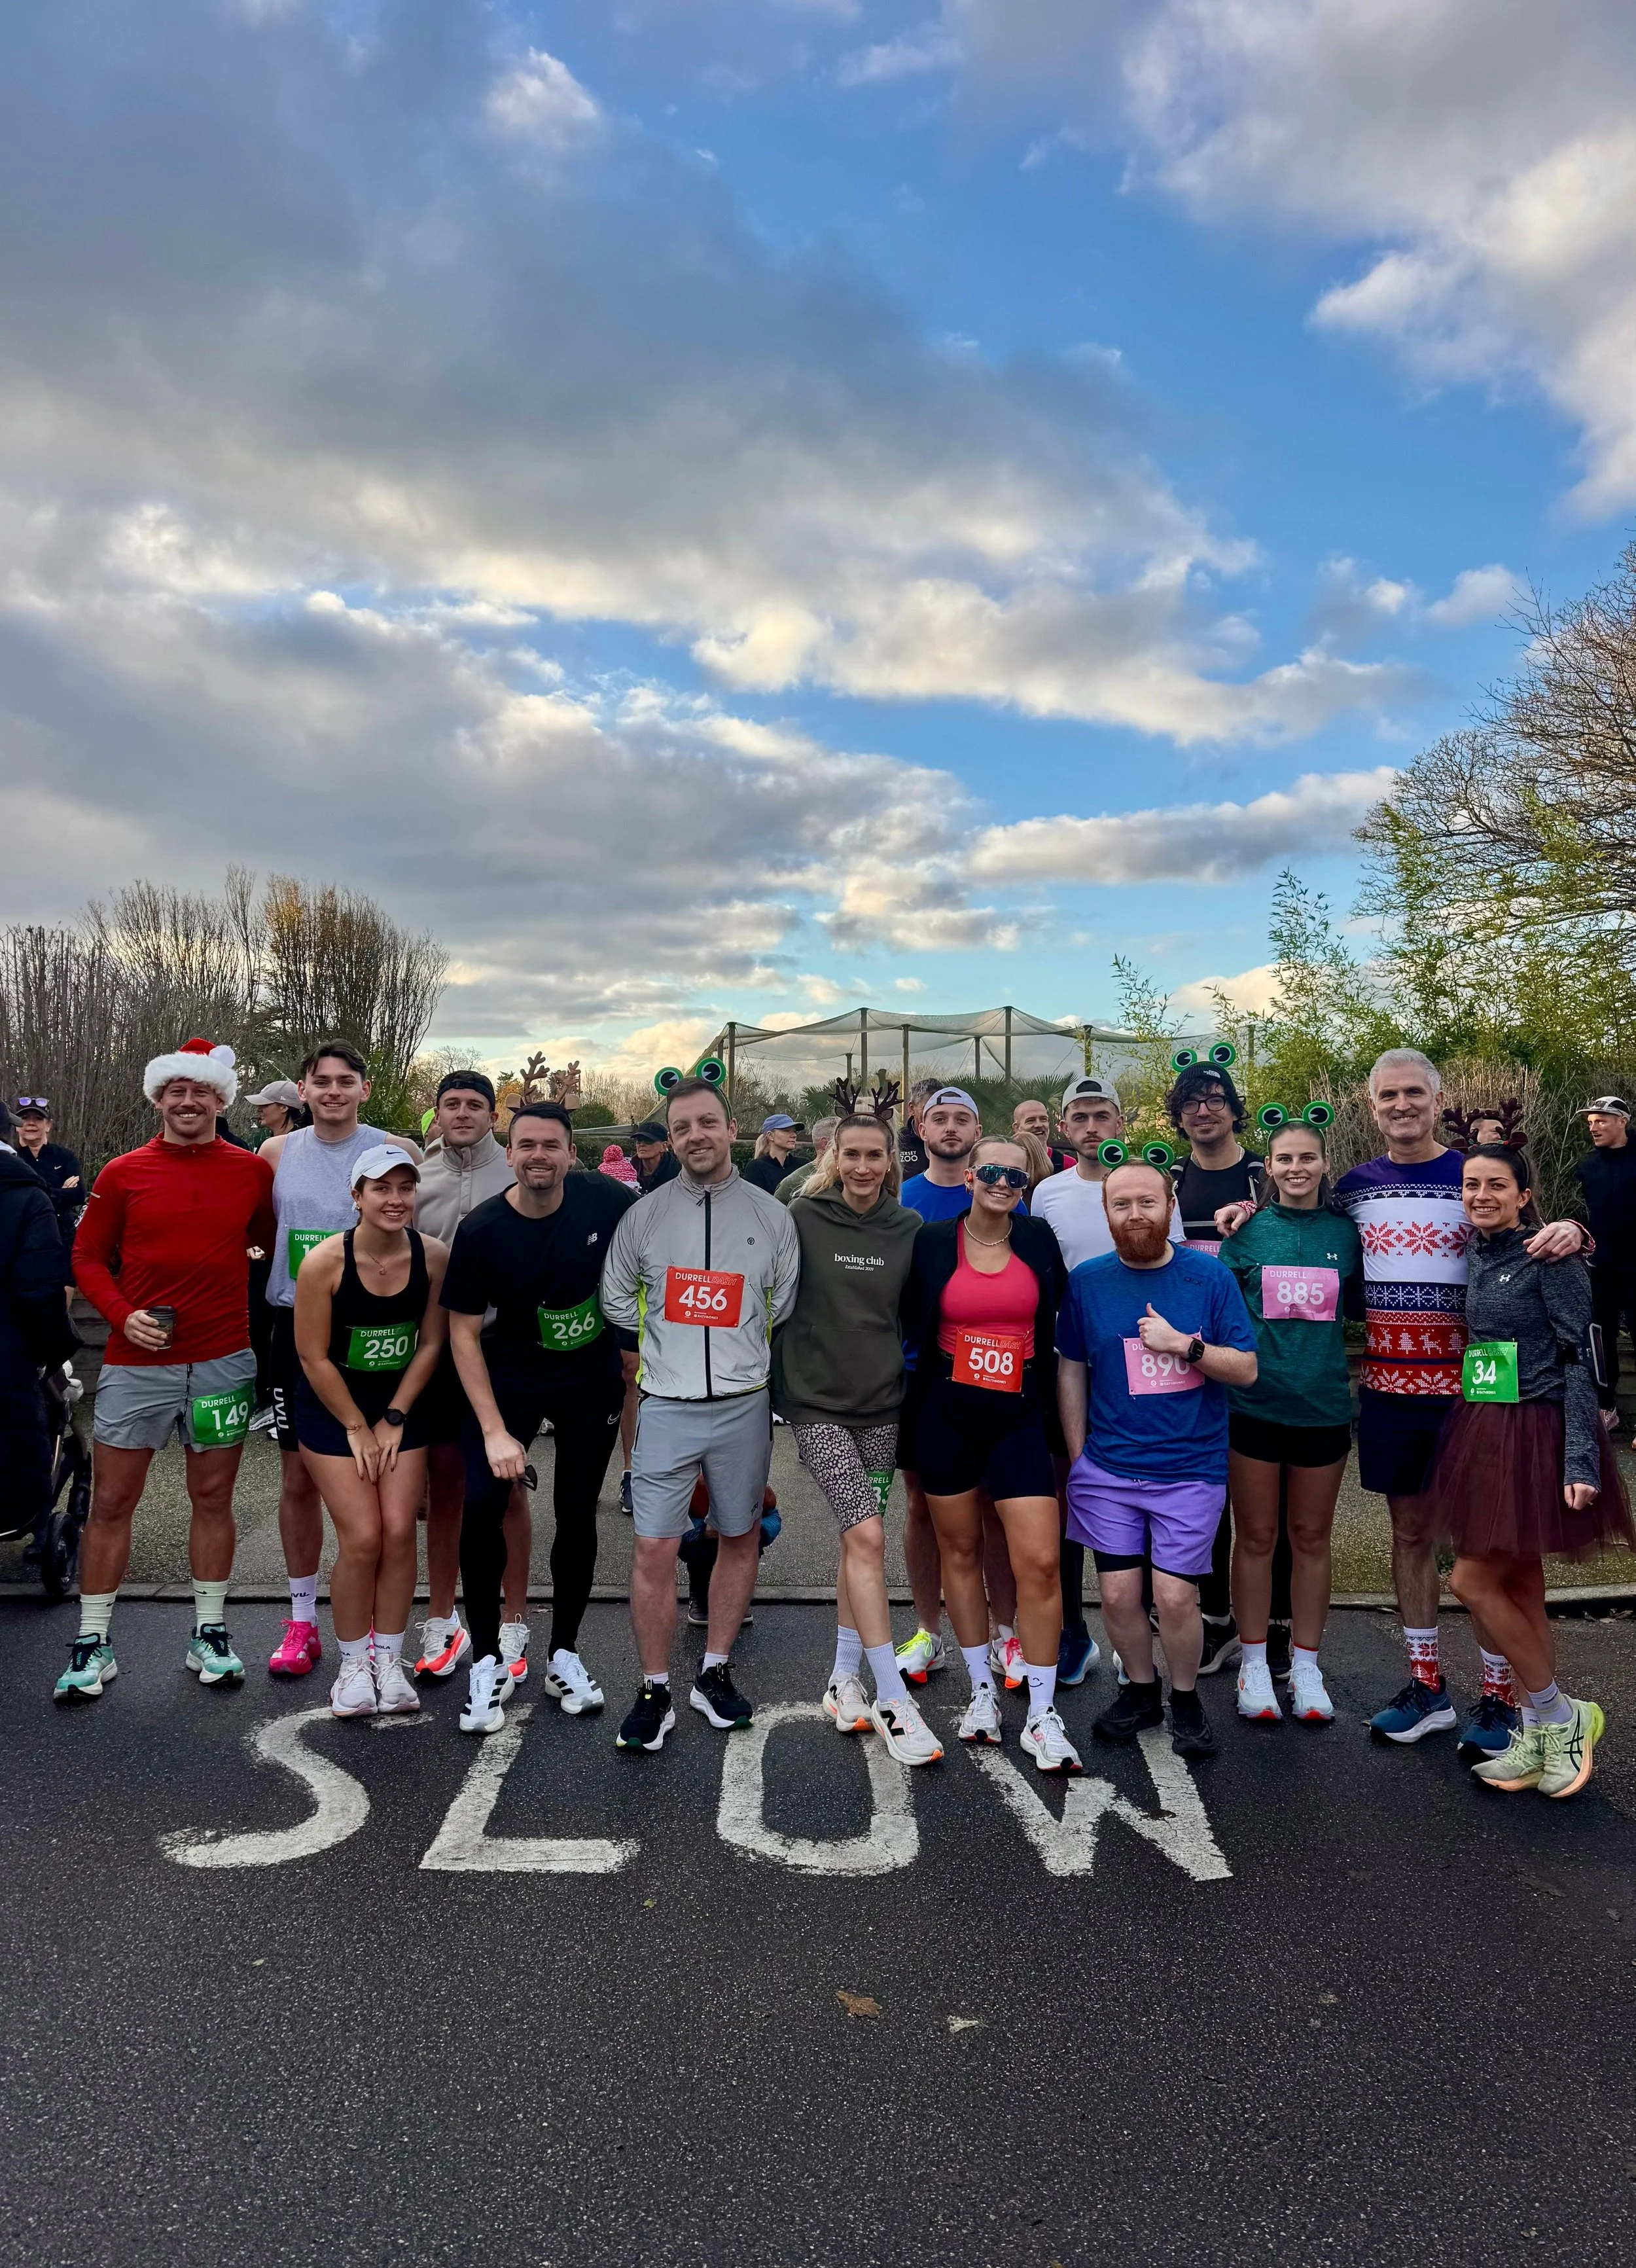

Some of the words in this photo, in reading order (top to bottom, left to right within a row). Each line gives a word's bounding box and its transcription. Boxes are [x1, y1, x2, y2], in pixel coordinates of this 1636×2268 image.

[834, 1253, 865, 1266] boxing
[866, 1256, 885, 1266] club
[675, 1272, 711, 1283] DURRELL
[711, 1276, 737, 1286] DASH
[1270, 1270, 1307, 1279] DURRELL
[679, 1285, 728, 1311] 456
[1277, 1281, 1325, 1305] 885
[544, 1311, 578, 1320] DURRELL
[552, 1312, 596, 1339] 266
[360, 1328, 395, 1338] DURRELL
[964, 1335, 999, 1348] DURRELL
[363, 1335, 408, 1359] 250
[968, 1347, 1014, 1375] 508
[1141, 1352, 1190, 1378] 890
[1472, 1360, 1497, 1385] 34
[201, 1395, 236, 1409] DURRELL
[212, 1401, 249, 1430] 149
[156, 1702, 1234, 1882] SLOW
